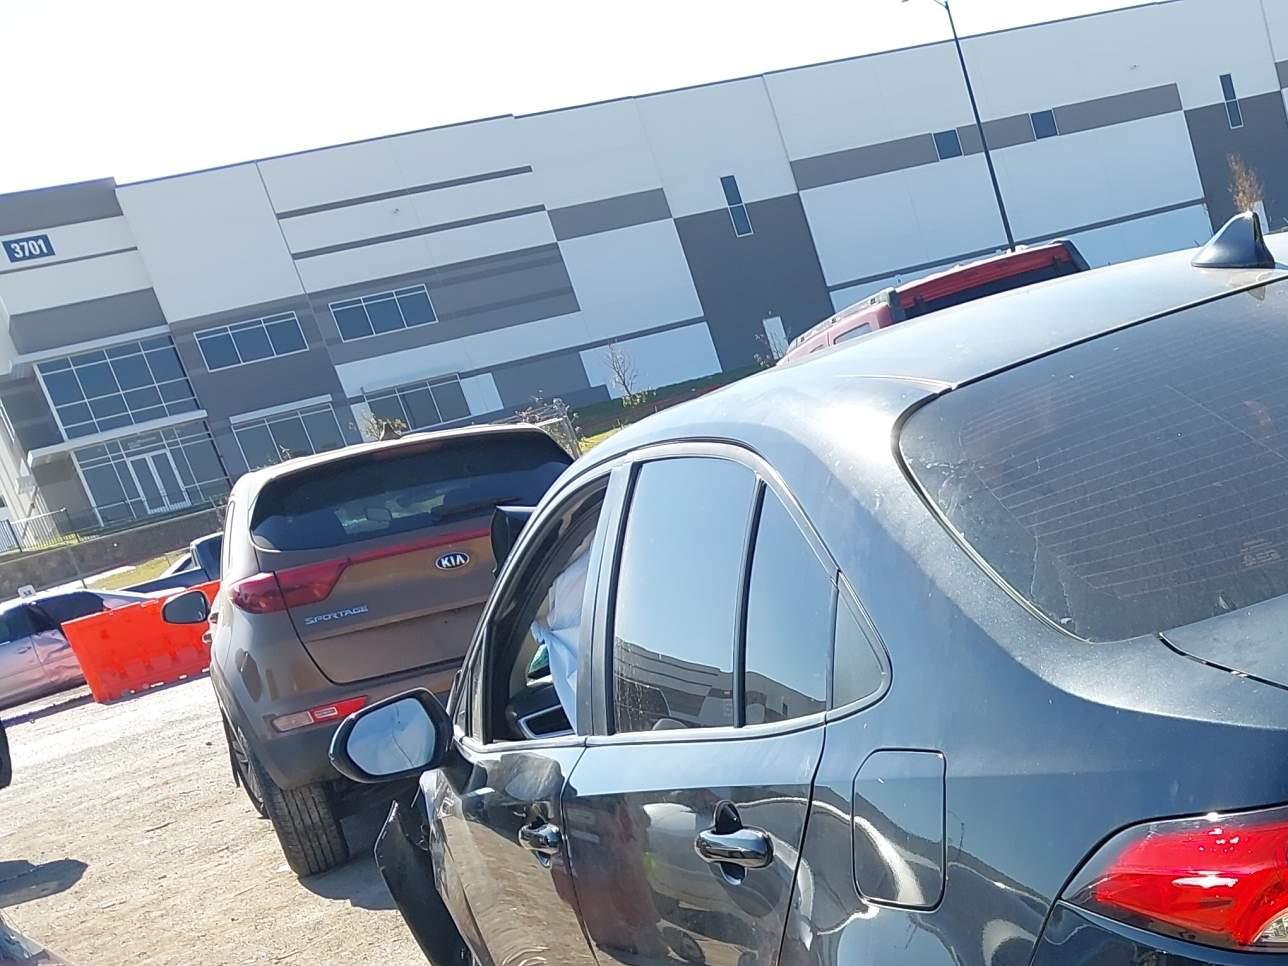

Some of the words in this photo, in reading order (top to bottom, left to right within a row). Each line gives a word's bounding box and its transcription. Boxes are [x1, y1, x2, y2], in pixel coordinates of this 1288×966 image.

[10, 239, 48, 258] 3701
[440, 554, 466, 569] KIA
[304, 605, 368, 625] SPORTAGE
